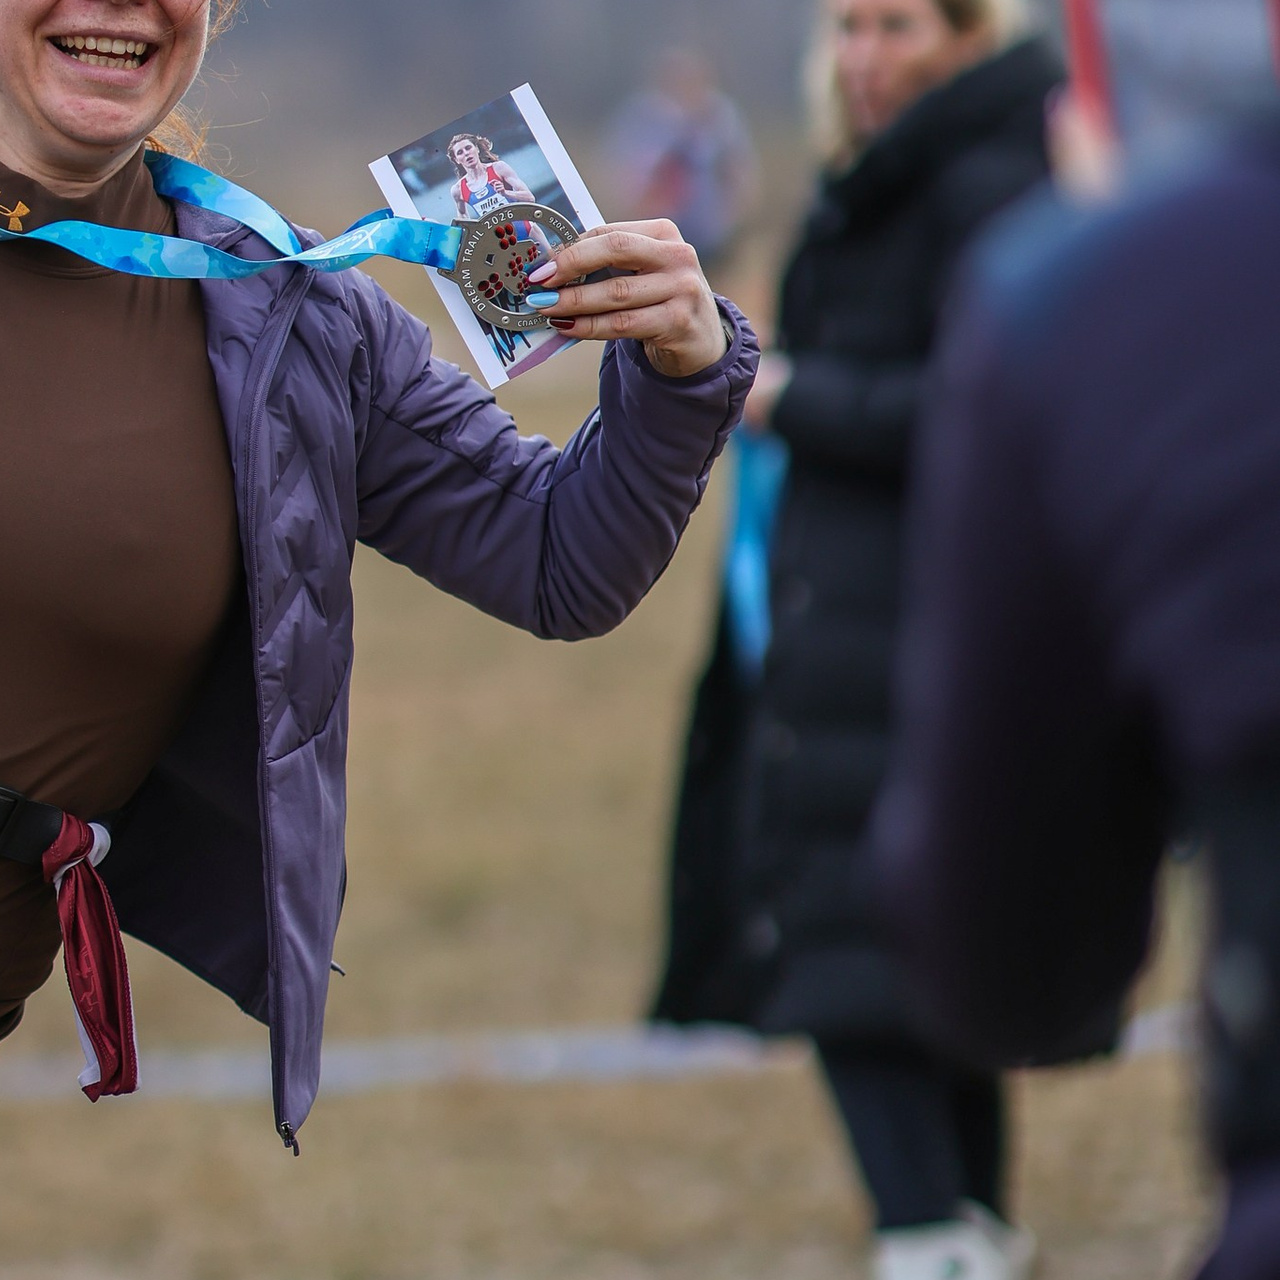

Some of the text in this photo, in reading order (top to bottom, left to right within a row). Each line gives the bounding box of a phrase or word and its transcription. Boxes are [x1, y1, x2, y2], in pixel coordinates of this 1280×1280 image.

[484, 210, 514, 229] 2026
[462, 229, 485, 263] TRAIL
[462, 269, 486, 312] DREAM
